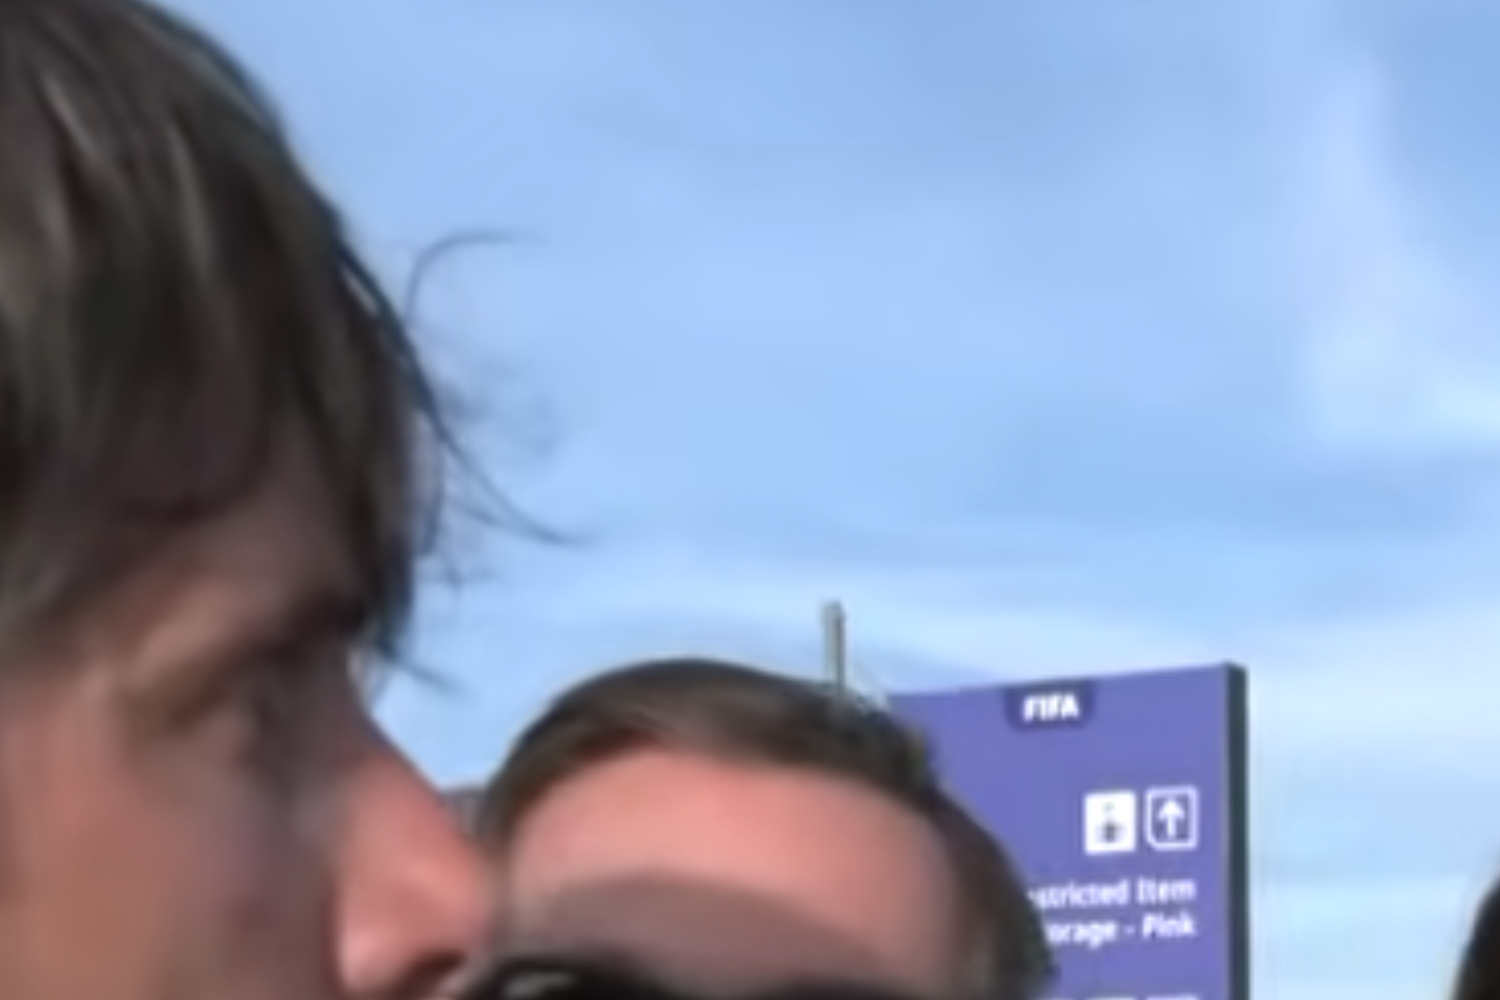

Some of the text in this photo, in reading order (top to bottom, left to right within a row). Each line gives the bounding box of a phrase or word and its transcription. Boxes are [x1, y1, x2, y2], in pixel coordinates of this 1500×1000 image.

[1022, 692, 1081, 722] FIFA
[1028, 876, 1196, 909] stricted Item
[1047, 921, 1117, 949] orage
[1142, 912, 1197, 938] Pink
